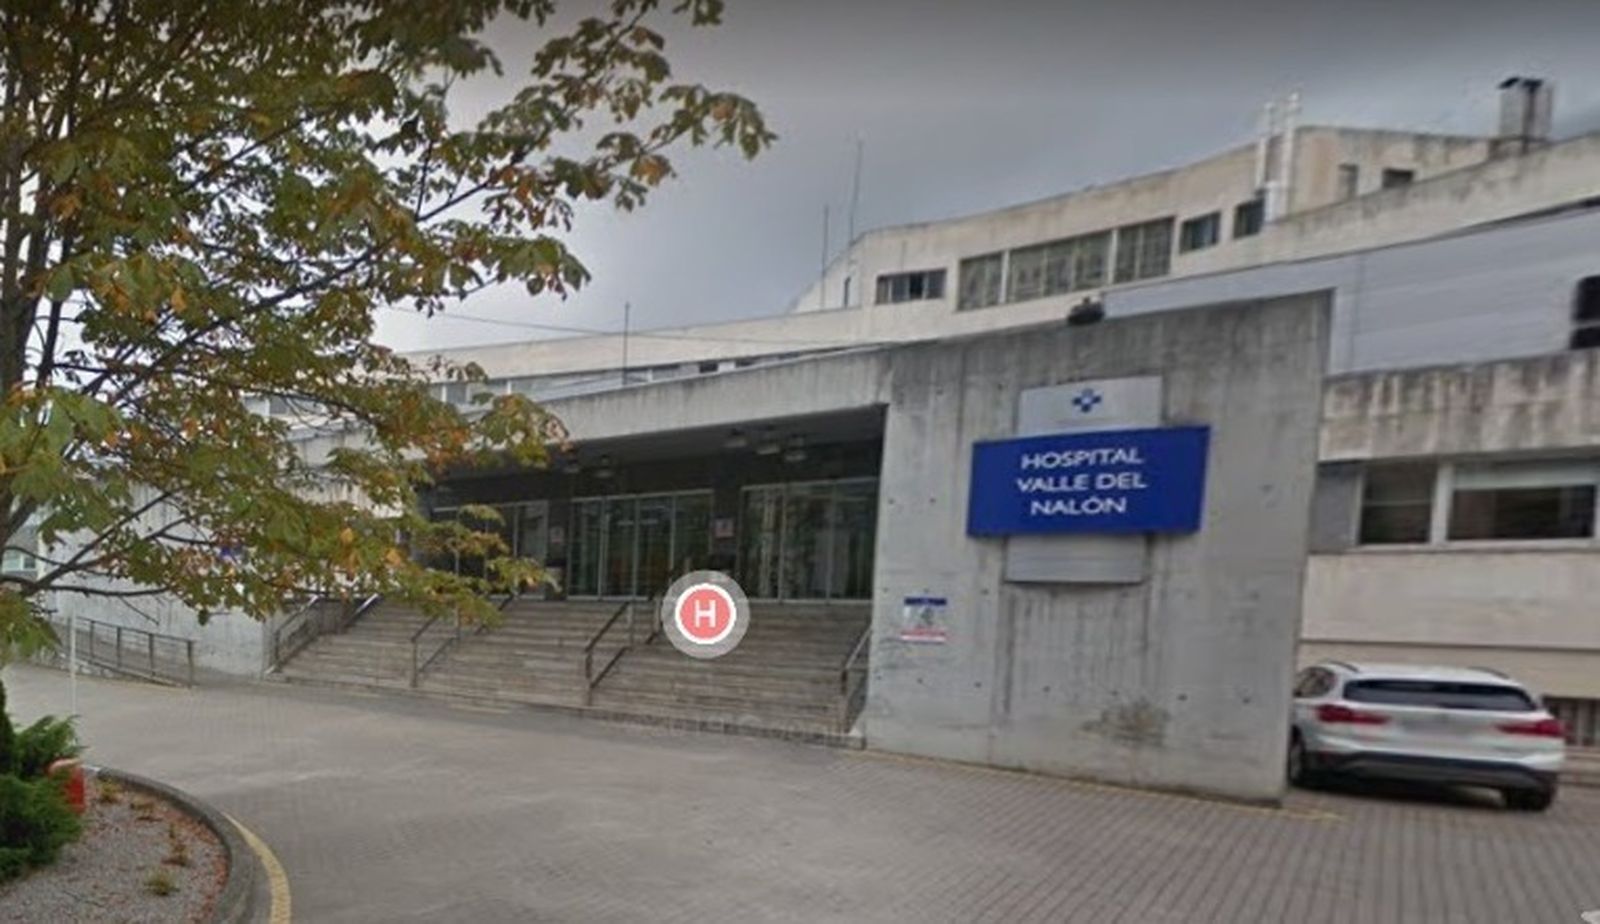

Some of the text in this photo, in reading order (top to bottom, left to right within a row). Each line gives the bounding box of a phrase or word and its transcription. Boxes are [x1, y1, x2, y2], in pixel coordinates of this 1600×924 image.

[1020, 447, 1144, 469] HOSPITAL
[1016, 472, 1148, 492] VALLE DEL
